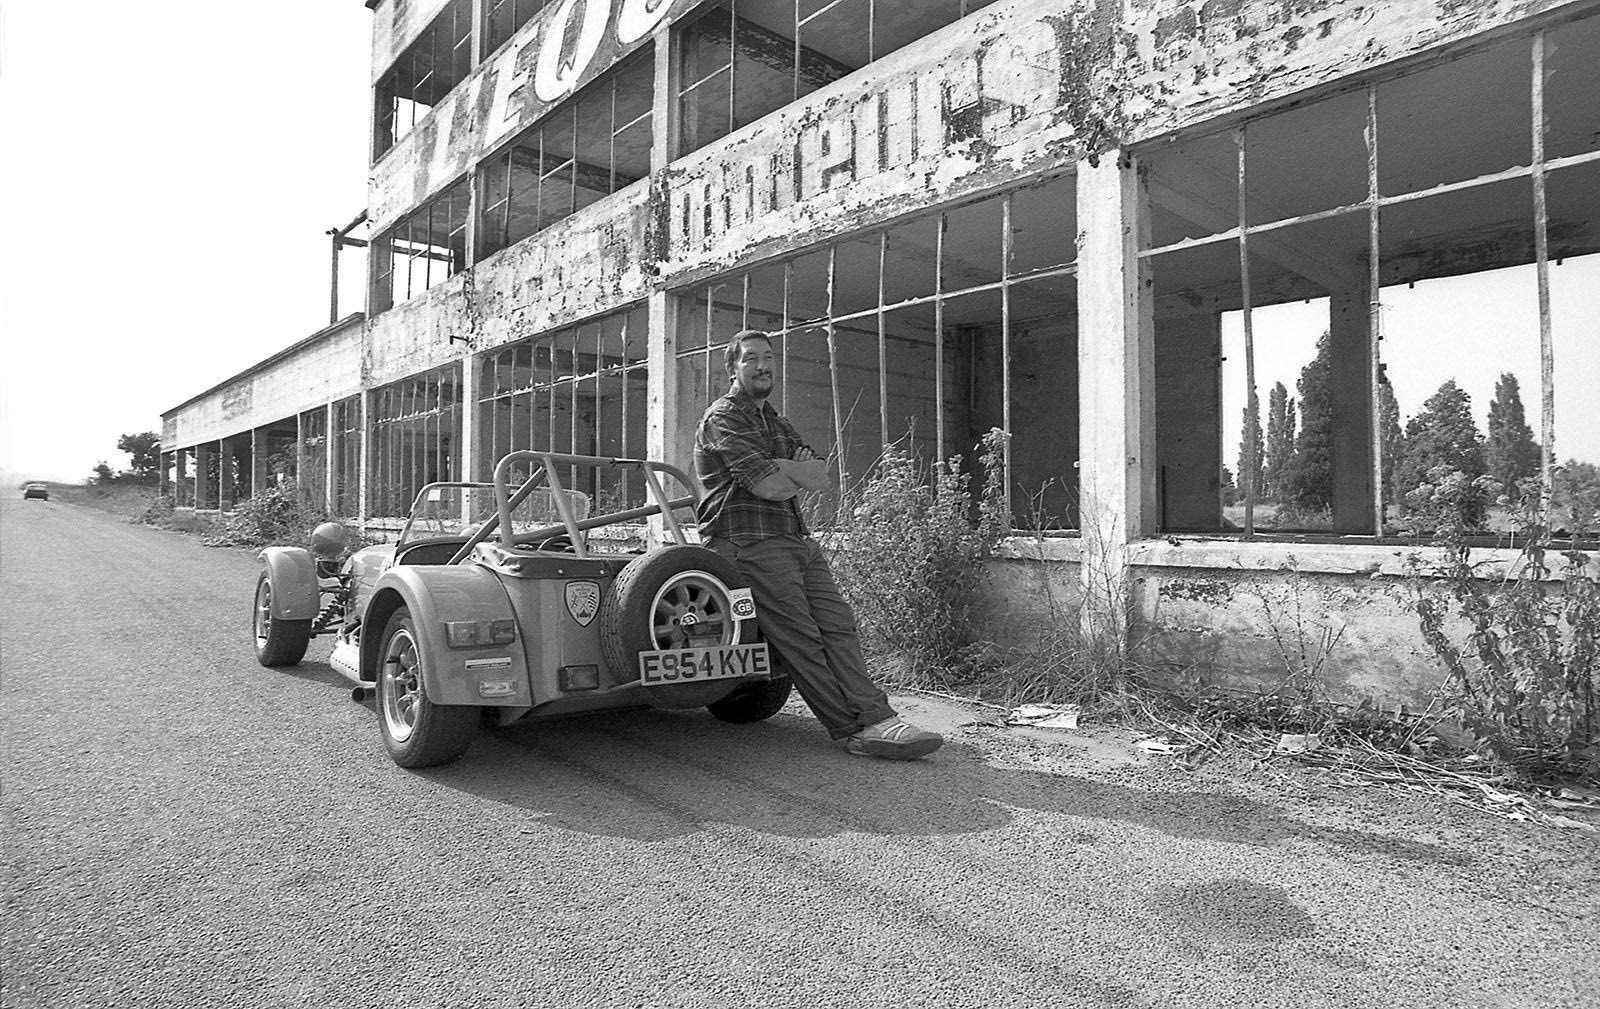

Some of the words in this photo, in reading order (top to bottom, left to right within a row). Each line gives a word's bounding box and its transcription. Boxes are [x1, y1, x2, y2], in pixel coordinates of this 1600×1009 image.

[738, 603, 752, 613] GB
[643, 651, 714, 683] E954
[719, 647, 768, 675] KYE
